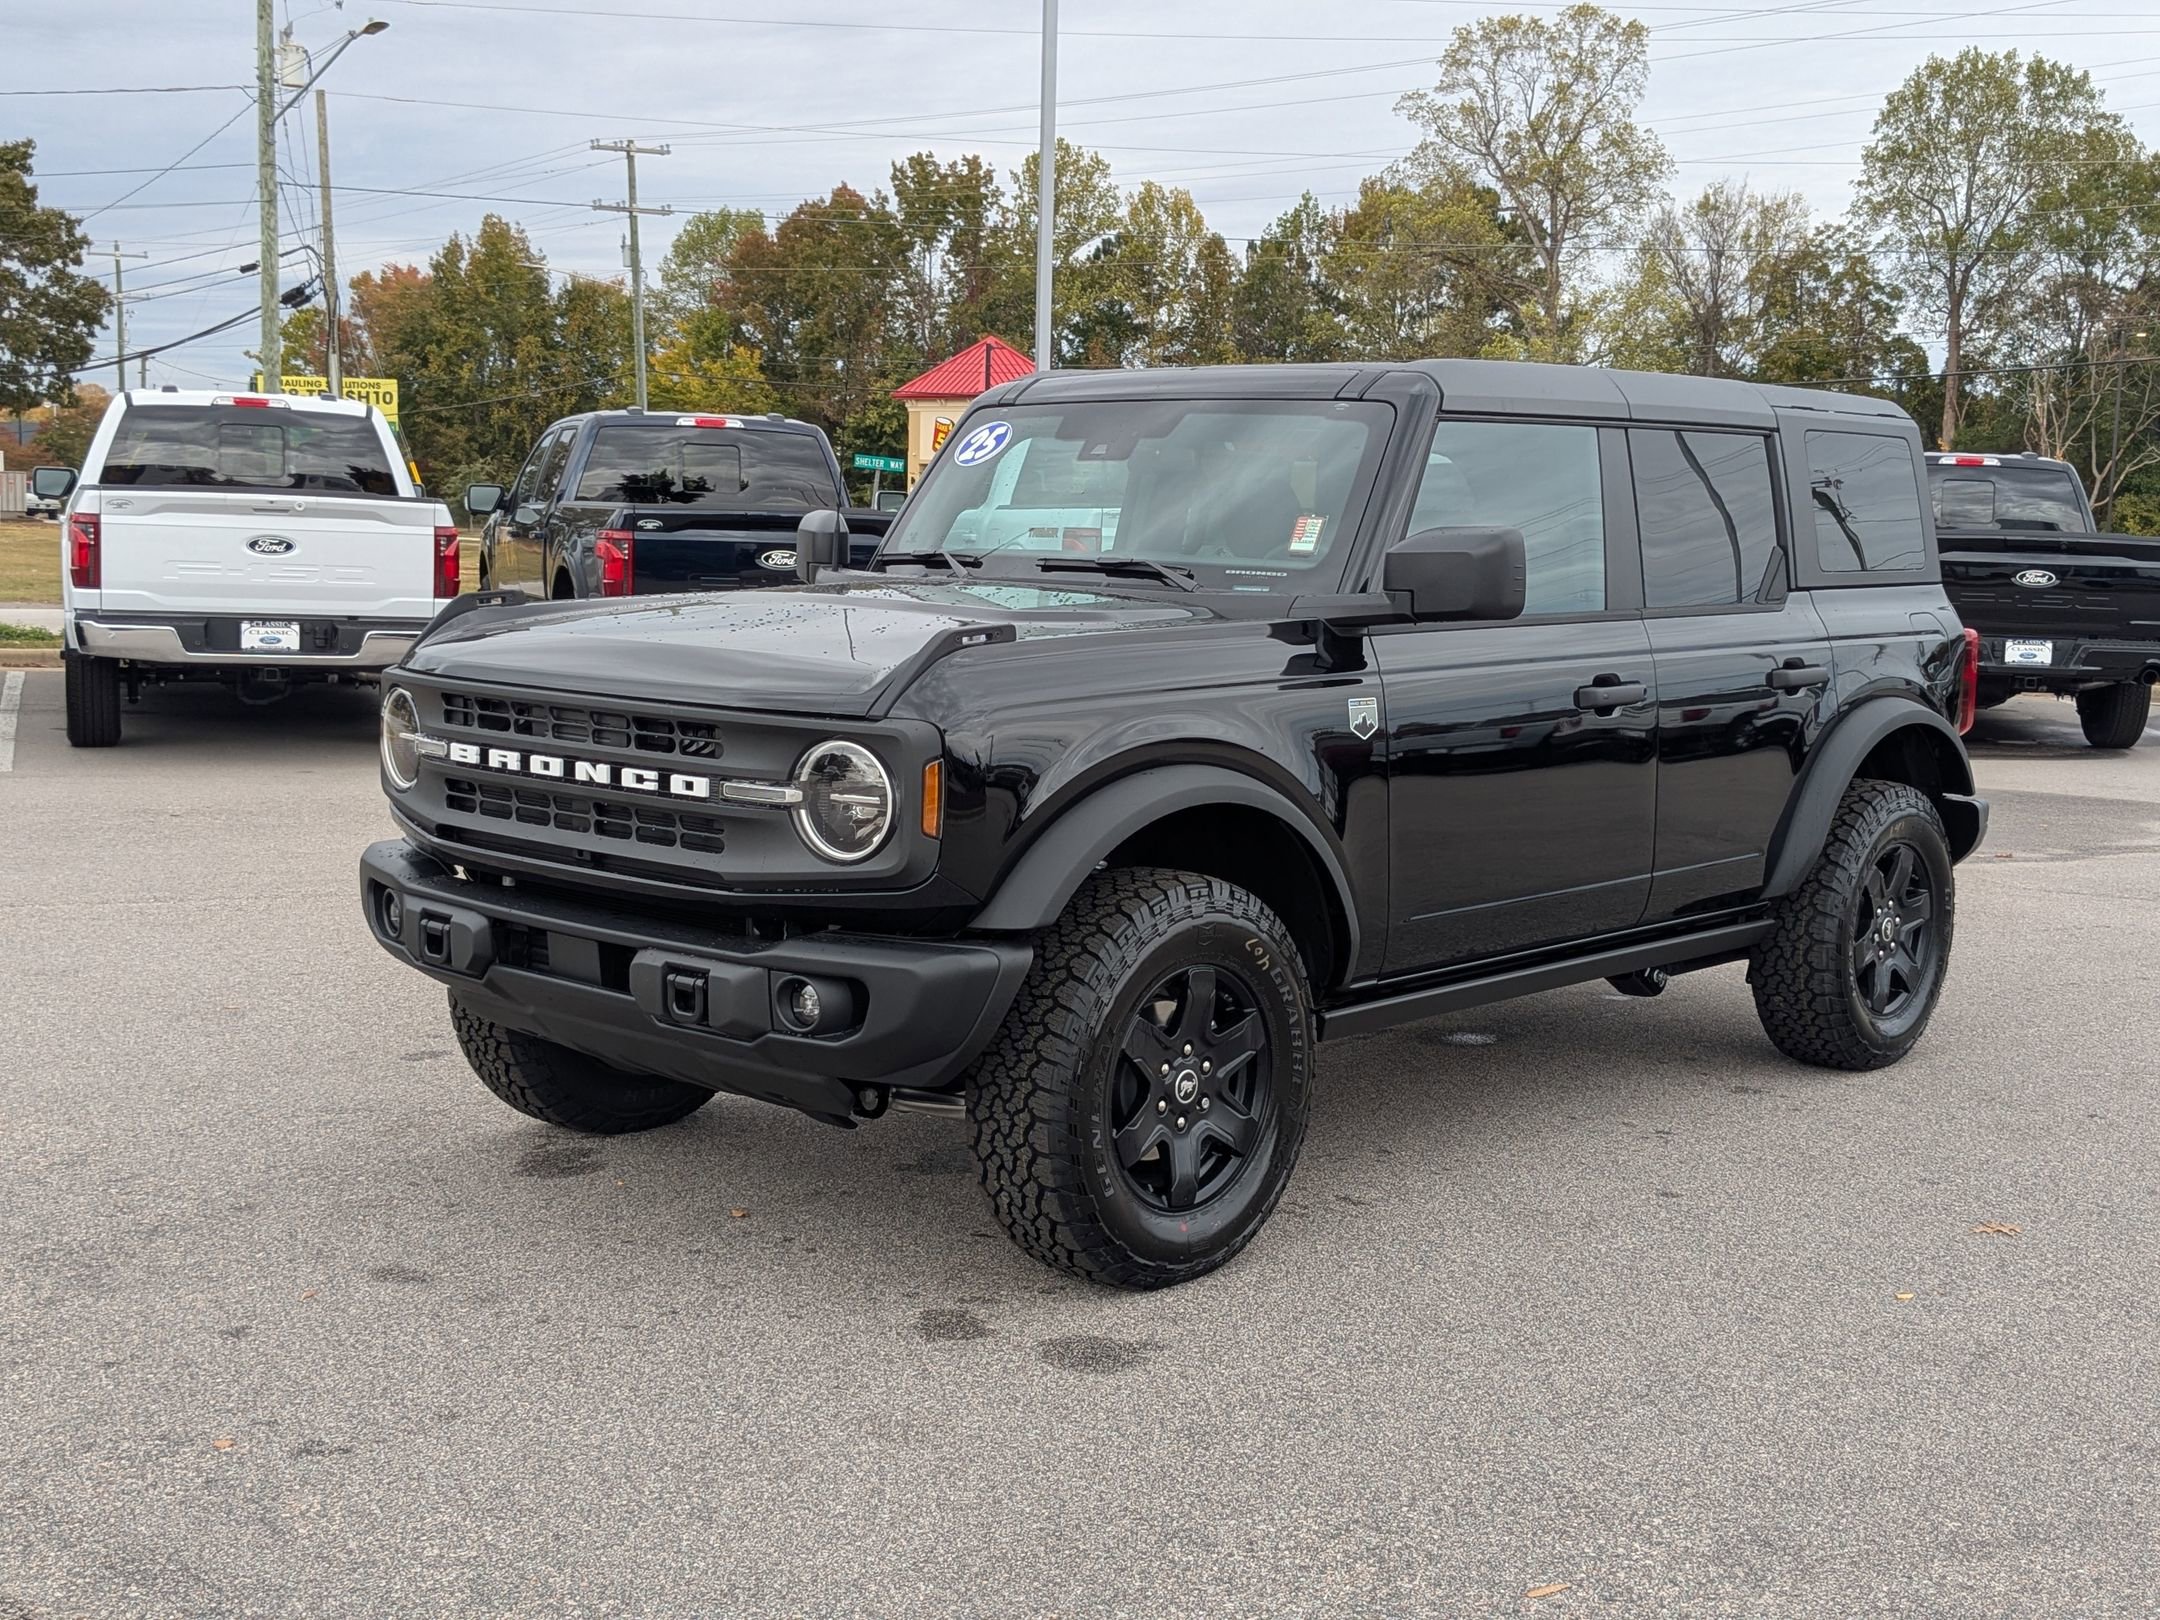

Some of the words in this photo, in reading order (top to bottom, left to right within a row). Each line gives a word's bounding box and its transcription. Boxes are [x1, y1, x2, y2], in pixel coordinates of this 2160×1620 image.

[281, 379, 322, 388] AULING
[958, 426, 1009, 461] 25
[855, 456, 885, 469] SHELTER
[890, 460, 904, 470] WAY
[253, 620, 289, 628] CLASSIC
[449, 742, 710, 798] BRONCO
